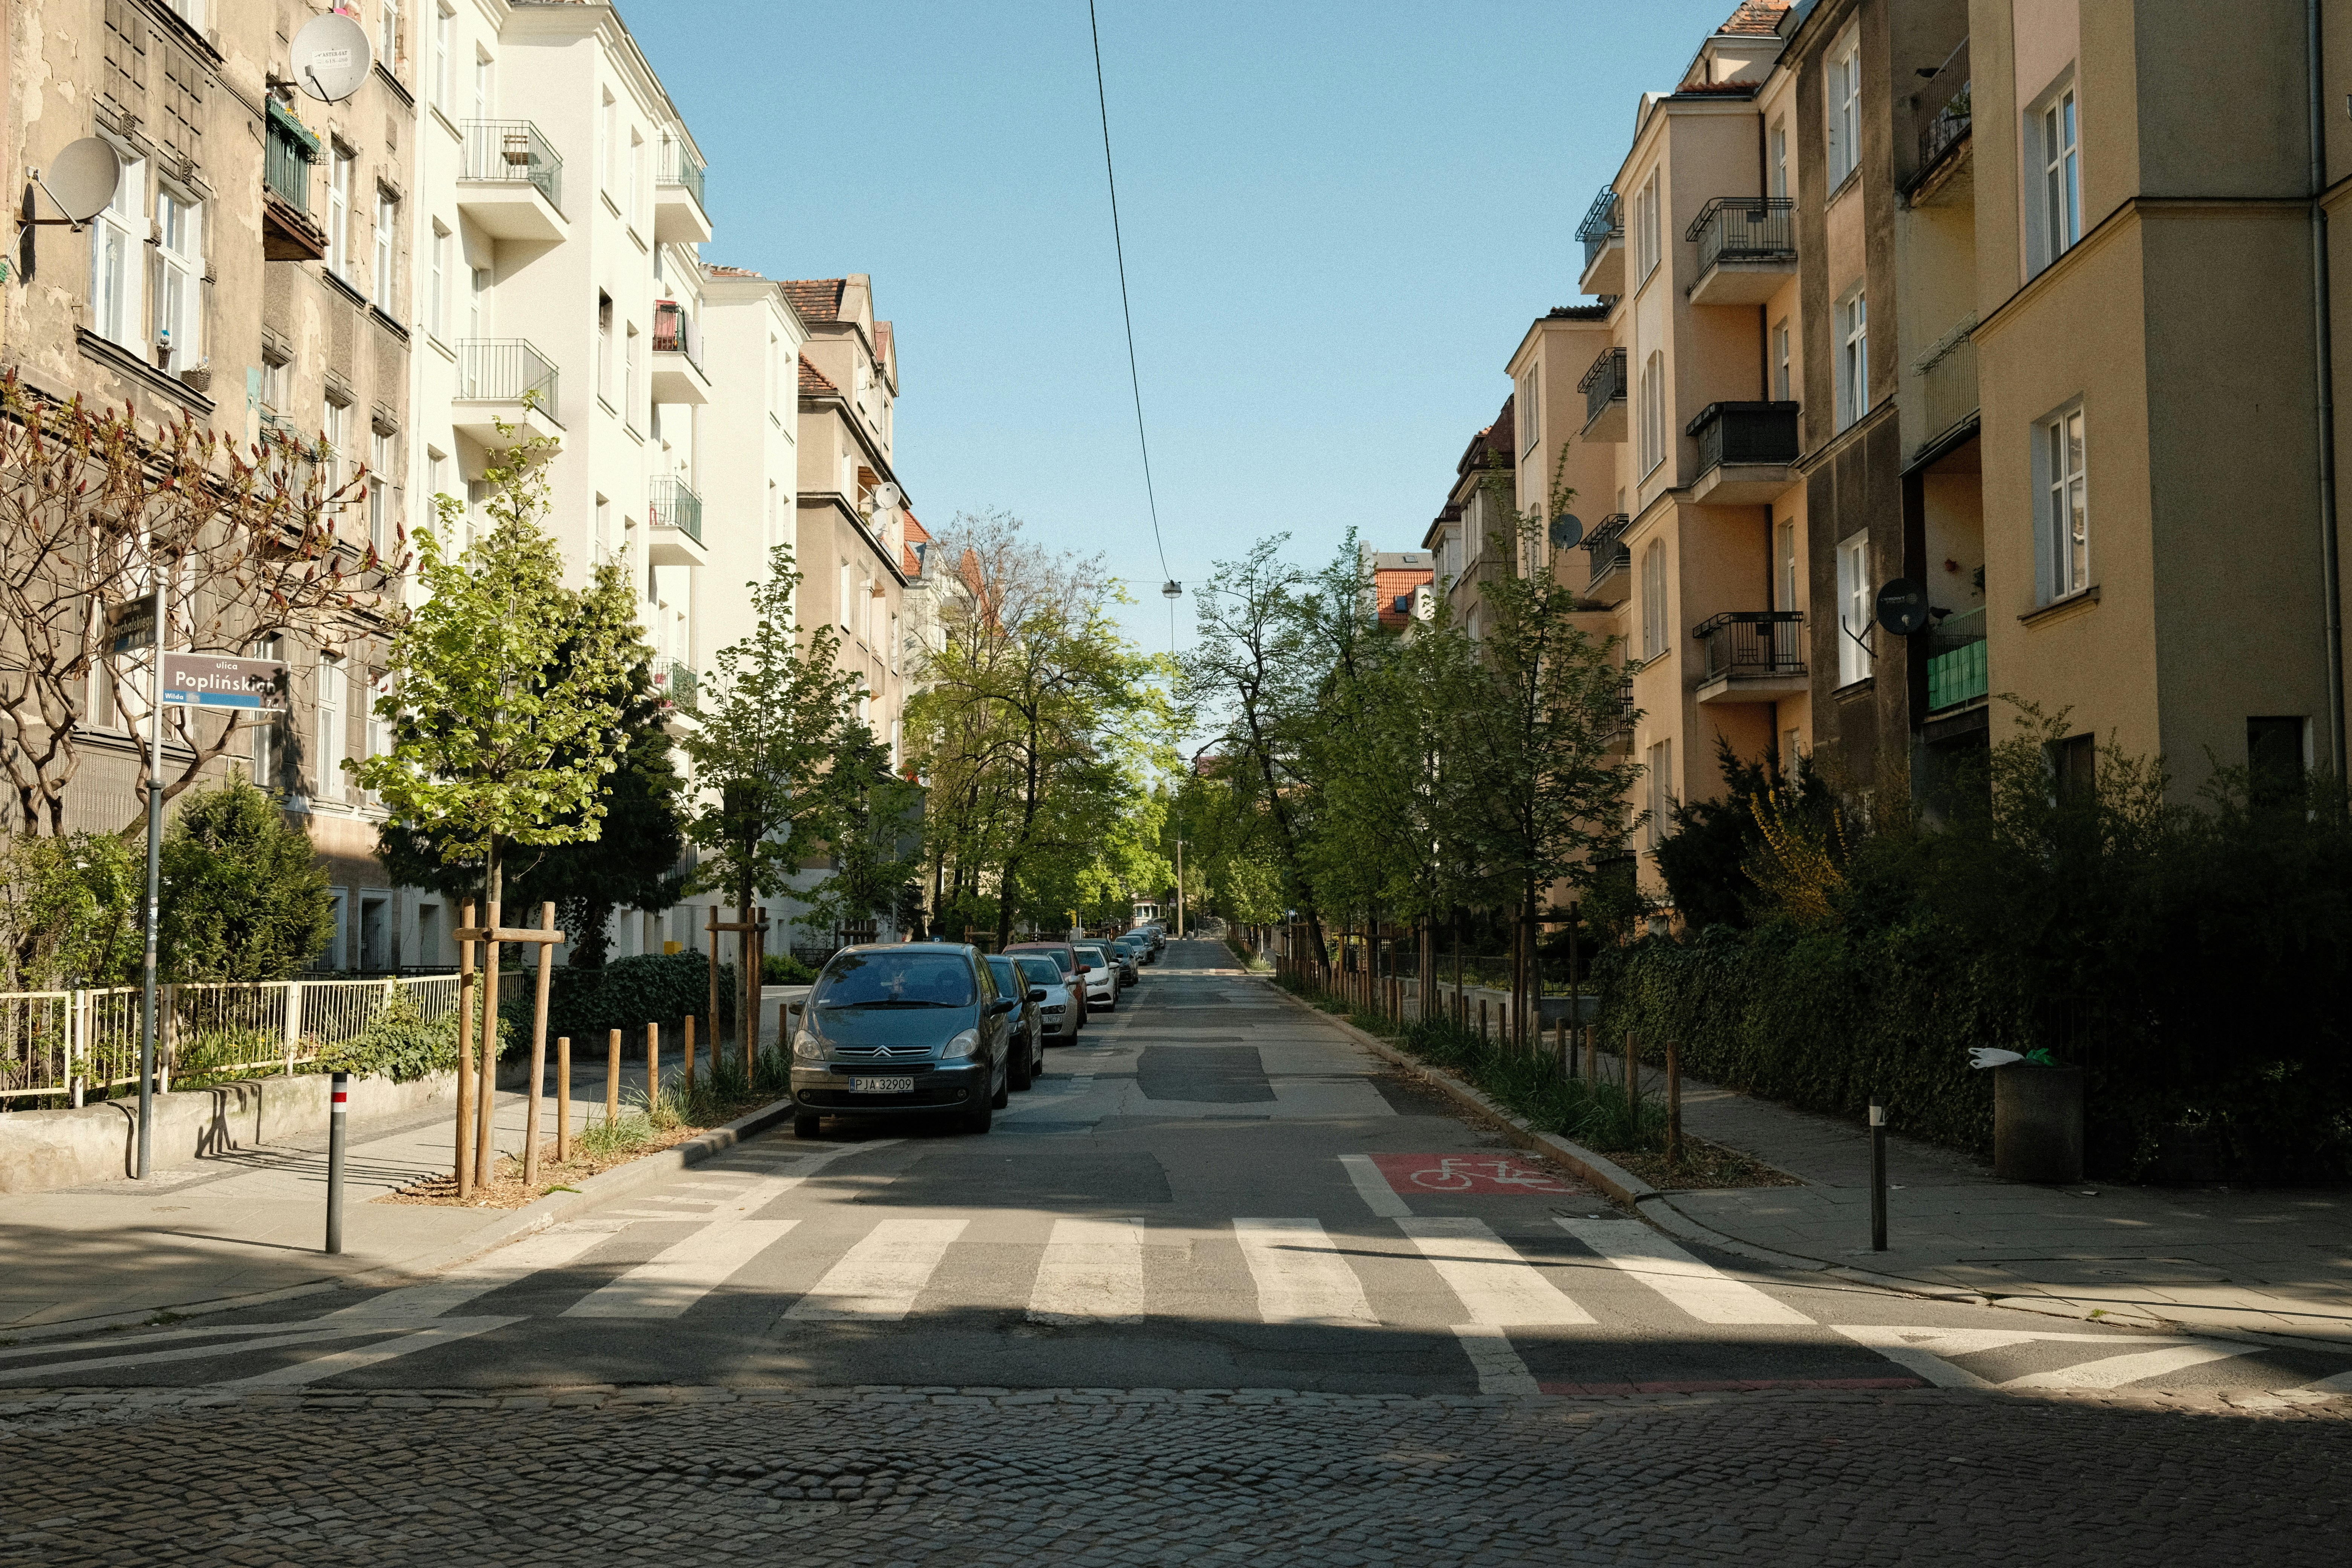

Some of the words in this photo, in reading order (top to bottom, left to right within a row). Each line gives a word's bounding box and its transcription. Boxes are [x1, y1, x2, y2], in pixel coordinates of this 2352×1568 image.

[110, 614, 154, 641] Spychalskiego
[176, 671, 276, 693] Poplińskich
[856, 1079, 876, 1090] PJA
[880, 1079, 911, 1089] 32909
